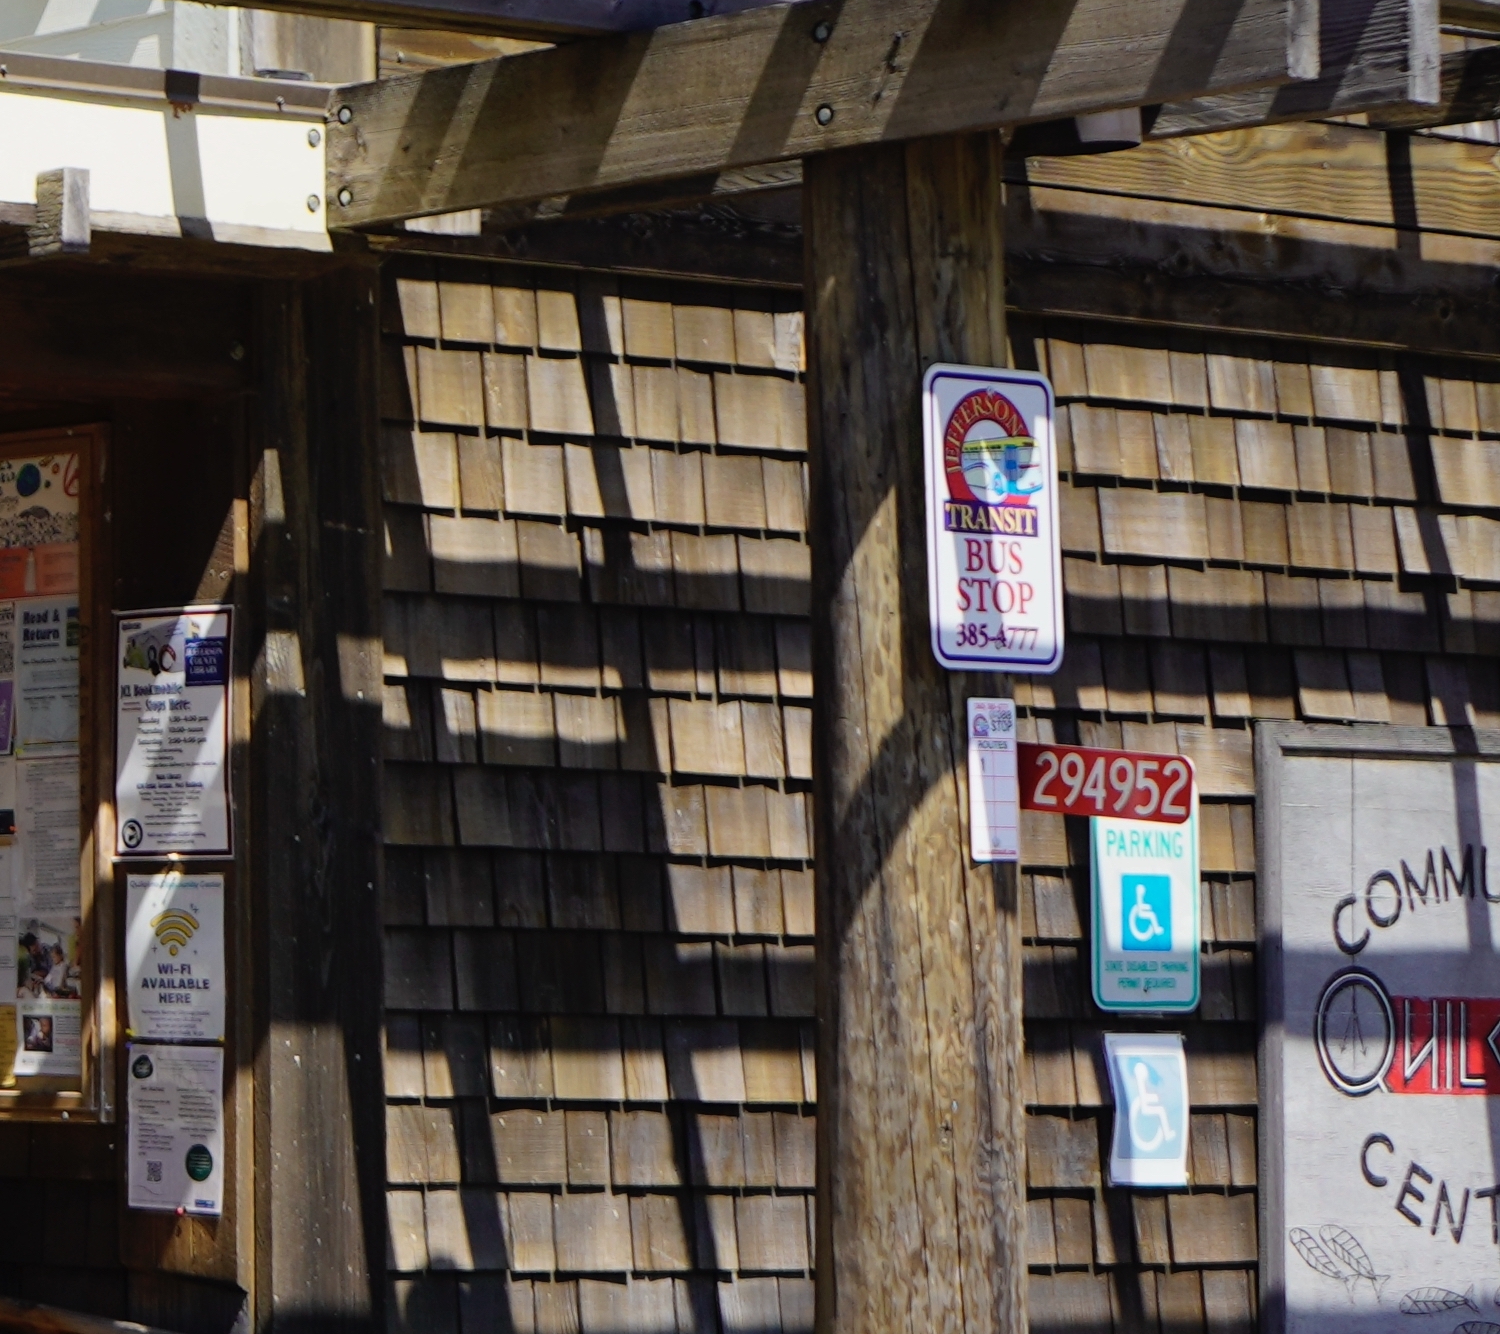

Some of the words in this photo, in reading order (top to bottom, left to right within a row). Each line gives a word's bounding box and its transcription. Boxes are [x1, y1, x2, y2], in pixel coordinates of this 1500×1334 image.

[946, 394, 1024, 473] JEFFERSON
[945, 503, 1037, 535] TRANSIT
[964, 537, 1023, 575] BUS
[957, 577, 1034, 615] STOP
[956, 623, 1039, 653] 385-4777
[1033, 750, 1189, 816] 294952
[1107, 829, 1184, 859] PARKING
[141, 978, 210, 990] AVAILABLE
[157, 962, 191, 975] WI-FI
[158, 992, 192, 1004] HERE
[1360, 1132, 1500, 1245] CENT
